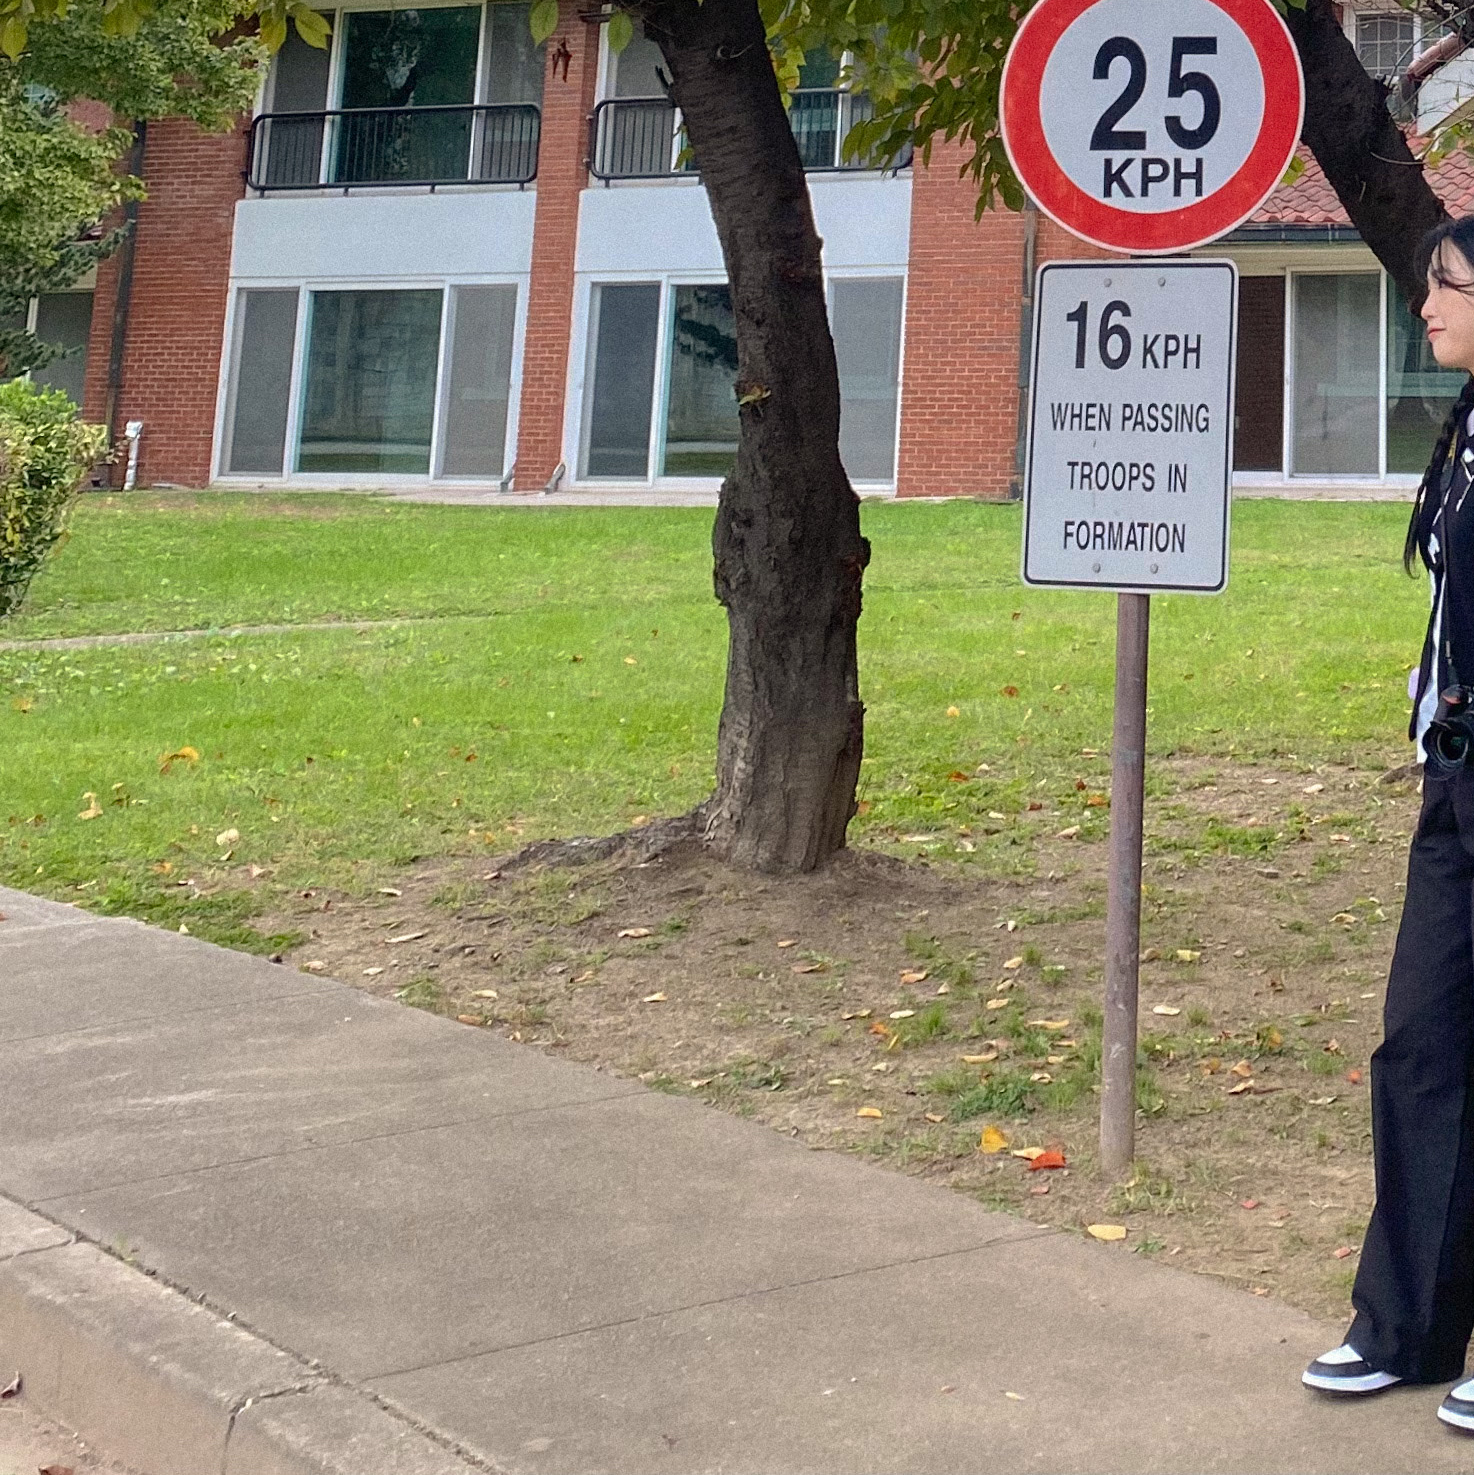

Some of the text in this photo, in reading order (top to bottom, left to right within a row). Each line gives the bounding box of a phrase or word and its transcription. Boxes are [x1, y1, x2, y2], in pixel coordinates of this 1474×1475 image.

[1089, 35, 1222, 151] 25
[1103, 157, 1204, 199] KPH
[1066, 299, 1202, 371] 16 KPH
[1050, 402, 1210, 434] WHEN PASSING
[1066, 461, 1188, 493] TROOPS IN
[1063, 520, 1186, 554] FORMATION
